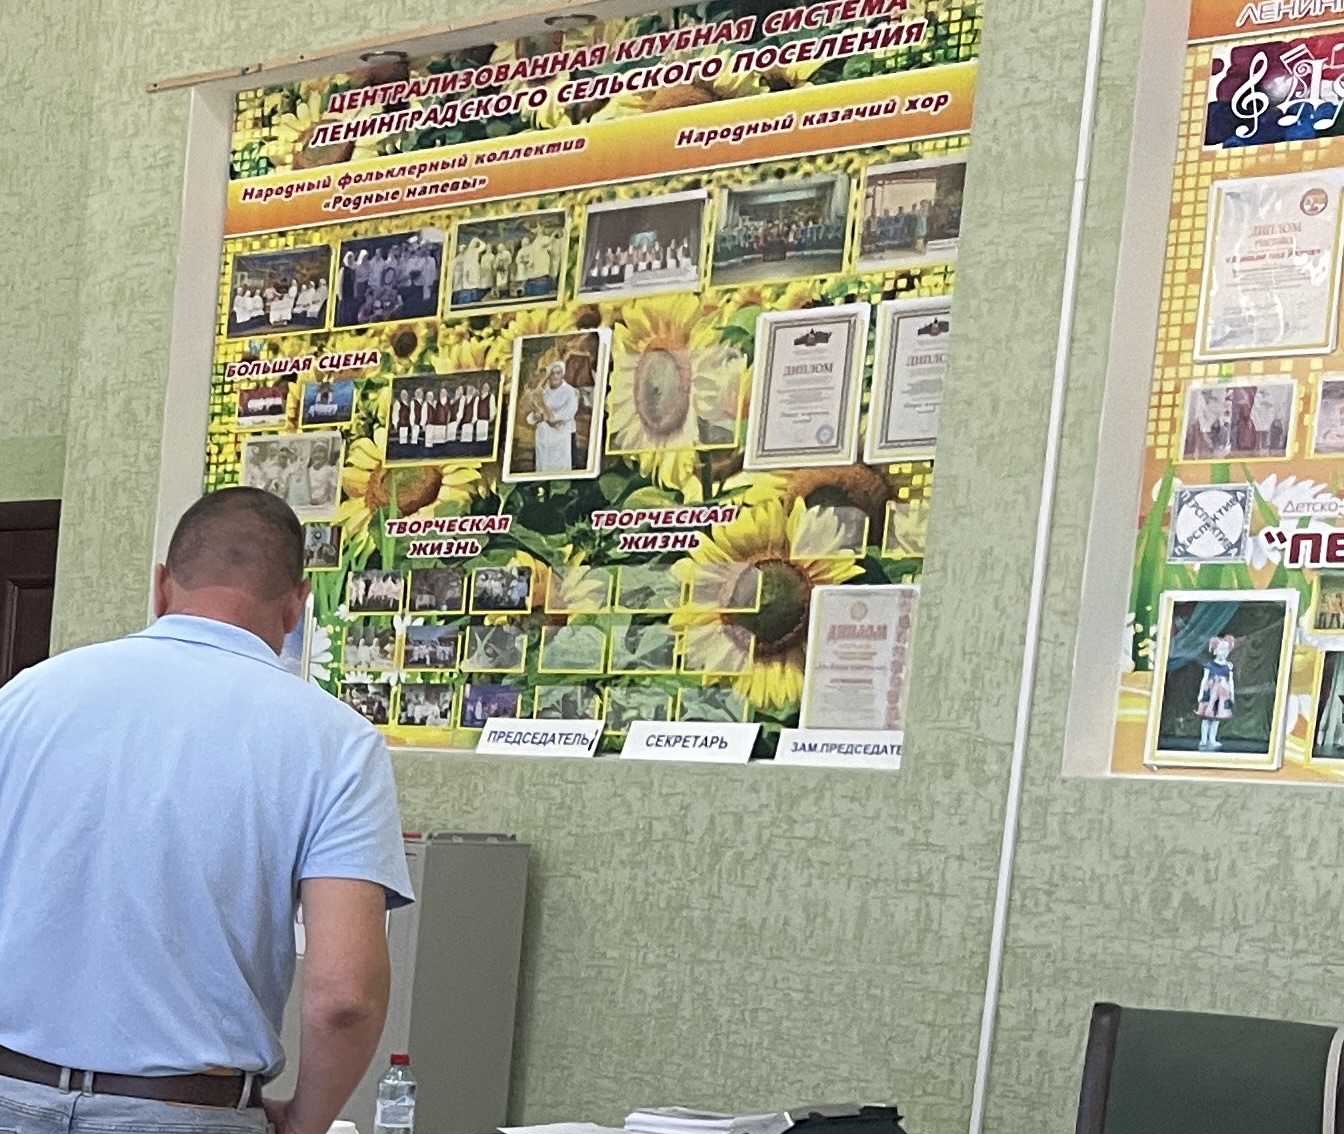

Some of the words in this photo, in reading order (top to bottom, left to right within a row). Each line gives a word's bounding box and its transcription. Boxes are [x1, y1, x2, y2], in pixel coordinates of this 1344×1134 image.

[327, 44, 607, 116] ЦЕНТРАЛИЗОВАННАЯ
[614, 16, 754, 66] КЛУБНАЯ
[764, 0, 908, 35] СИСТЕМА
[311, 89, 548, 147] ЛЕНИНГРАДСКОГО
[556, 58, 723, 103] СЕЛЬСКОГО
[732, 20, 926, 74] ПОСЕЛЕНИЯ
[676, 113, 793, 149] Народный
[802, 99, 897, 128] казачий
[905, 93, 949, 115] хор
[241, 175, 332, 203] Народный
[337, 154, 468, 192] фольклерный
[475, 137, 586, 166] коллектив
[322, 191, 401, 213] «Родные
[405, 177, 486, 203] напевы»
[226, 357, 313, 379] БОЛЬШАЯ
[318, 351, 379, 371] СЦЕНА
[386, 518, 510, 534] ТВОРЧЕСКАЯ
[593, 508, 734, 528] ТВОРЧЕСКАЯ
[410, 541, 480, 556] ЖИЗНЬ
[619, 534, 700, 551] ЖИЗНЬ
[487, 730, 590, 747] ПРЕДСЕДАТЕЛЬ
[645, 734, 729, 750] СЕКРЕТАРЬ
